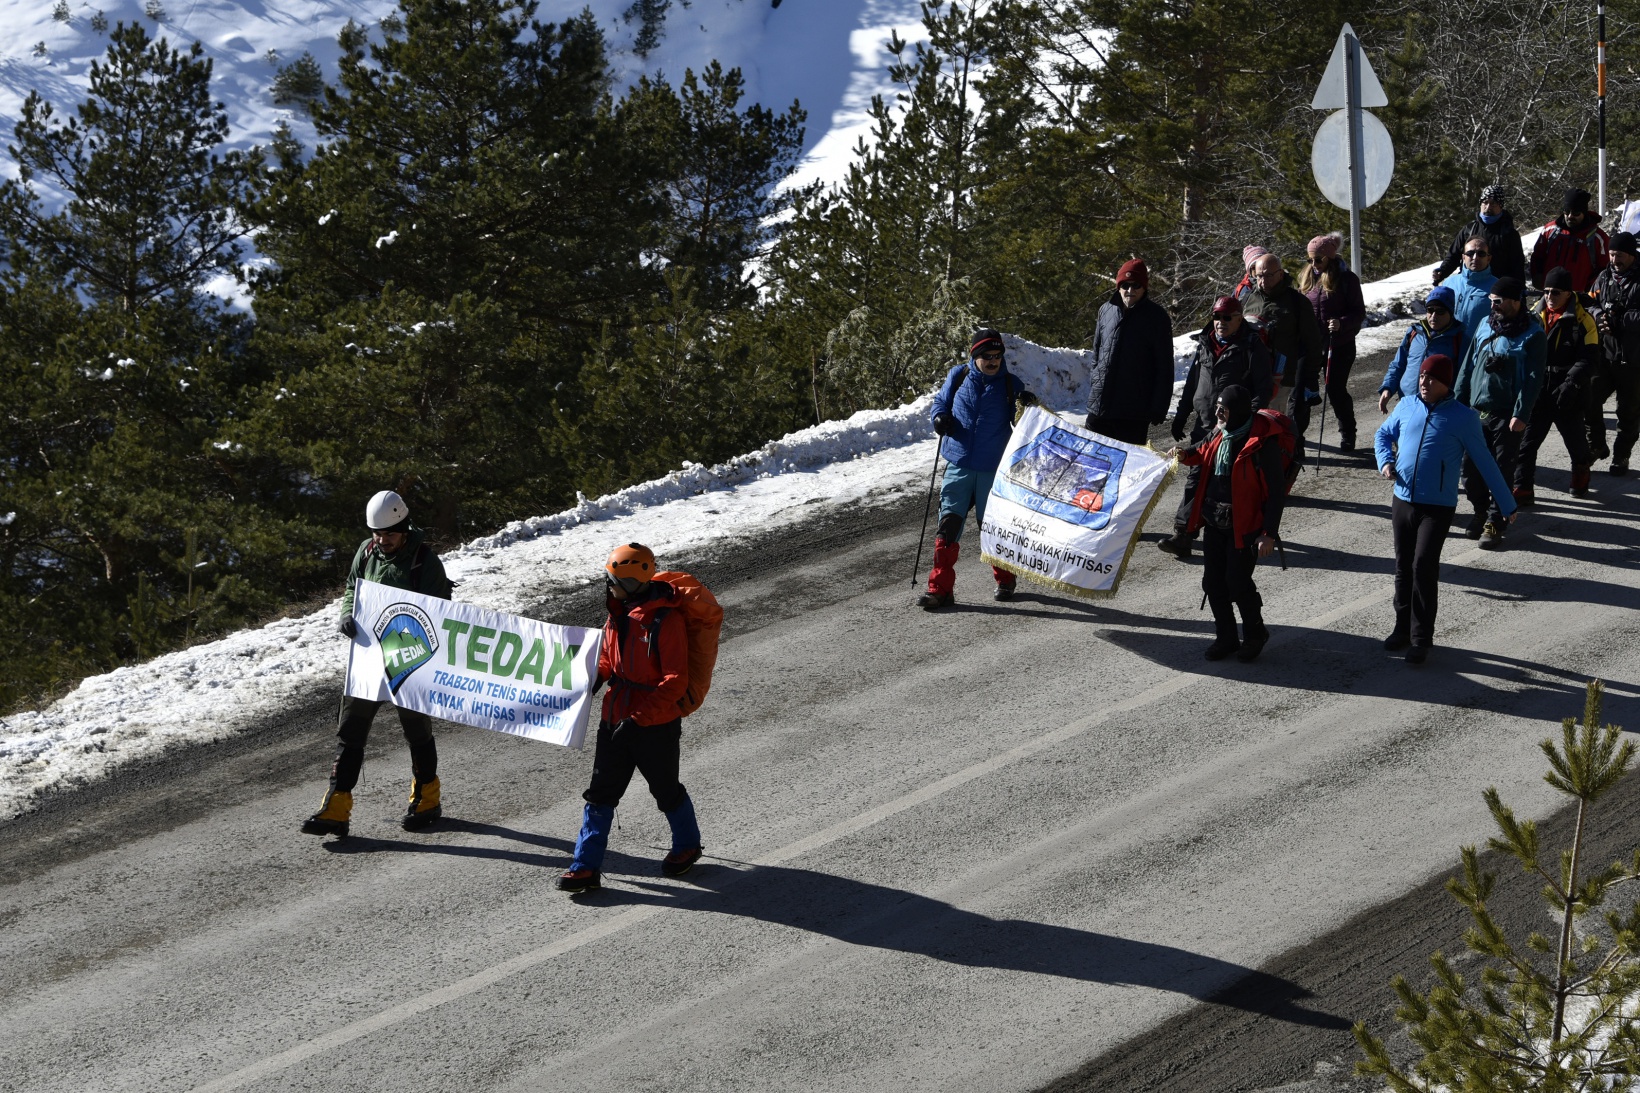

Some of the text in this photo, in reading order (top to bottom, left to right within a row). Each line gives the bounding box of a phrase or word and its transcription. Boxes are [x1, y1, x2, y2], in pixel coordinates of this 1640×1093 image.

[1010, 515, 1047, 536] KAÇKAR
[1030, 540, 1063, 560] KAYAK
[1062, 547, 1113, 575] İHTİSAS
[386, 643, 427, 668] TEDAK
[441, 618, 582, 690] TEDAK
[429, 689, 465, 711] KAYAK
[471, 697, 516, 722] İHTİSAS
[432, 669, 485, 694] TRABZON
[485, 682, 517, 702] TENİS
[518, 689, 573, 711] DAĞCILIK
